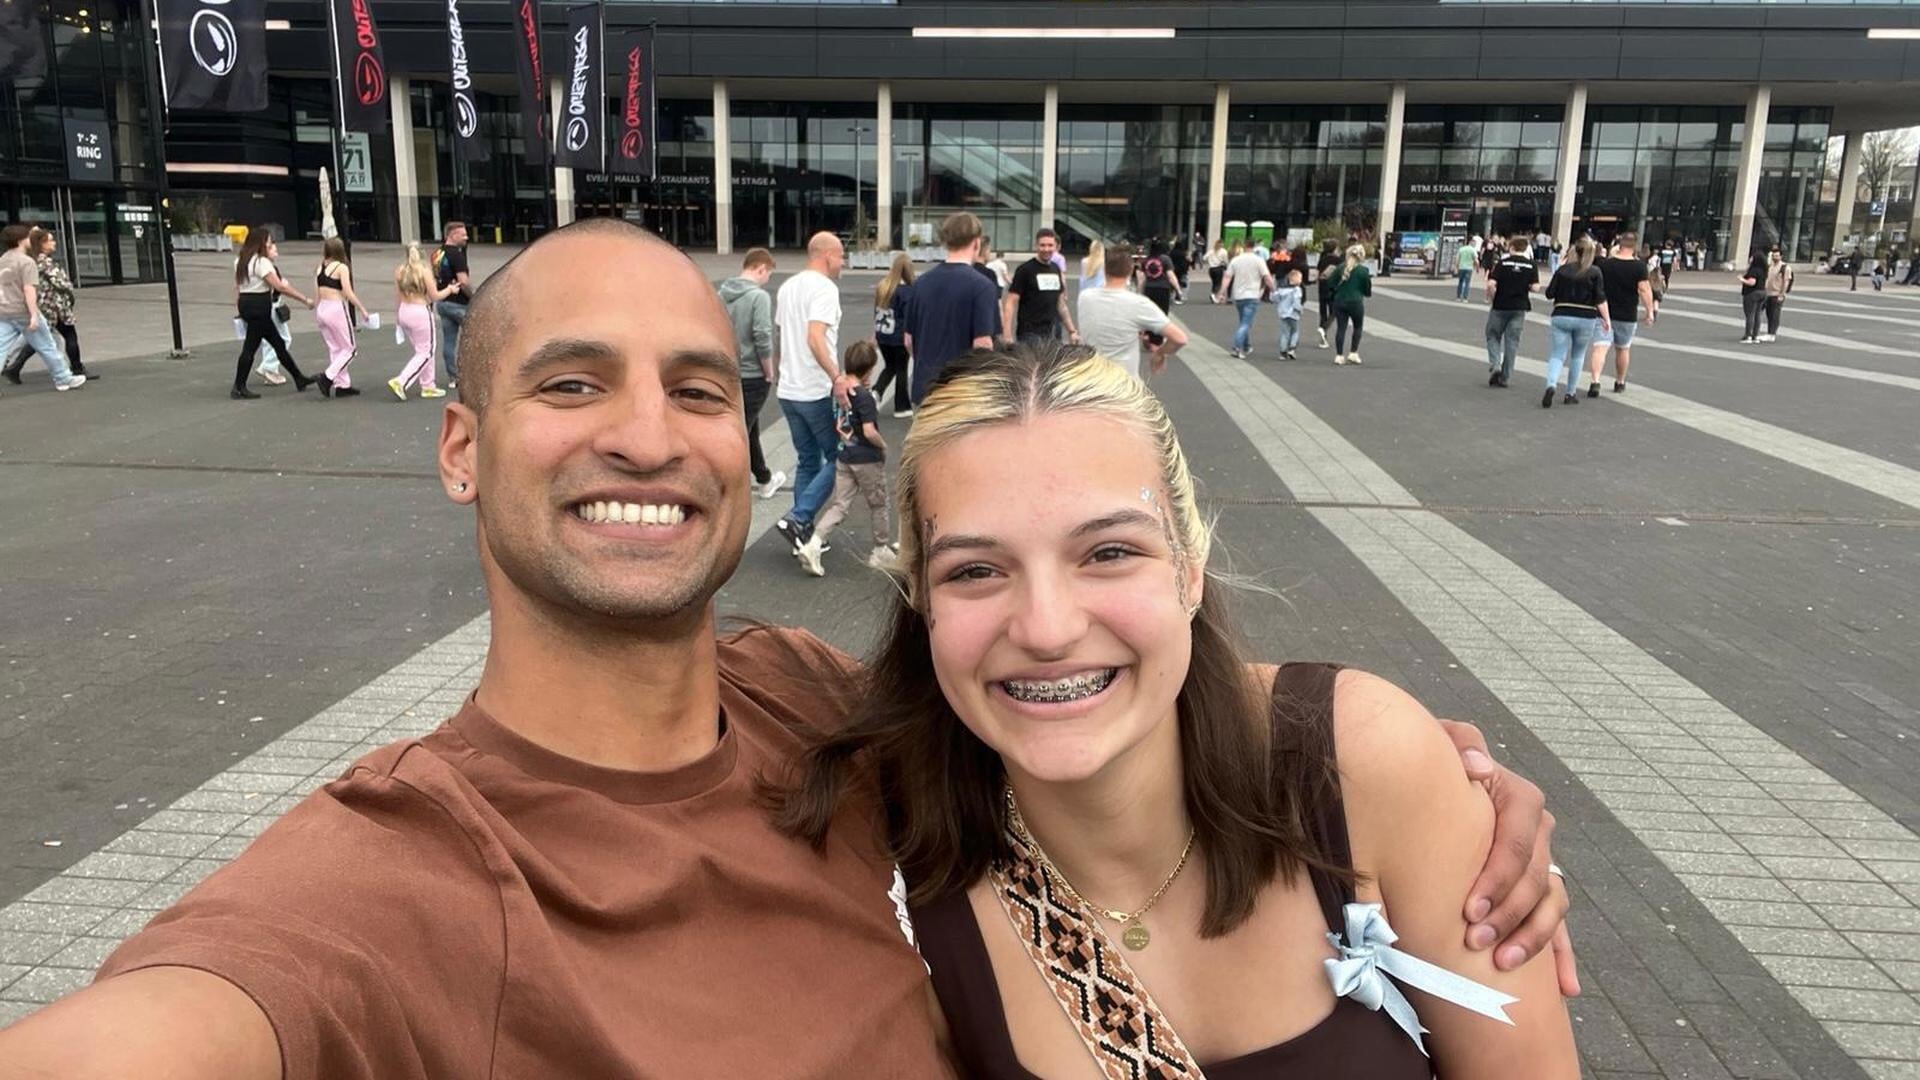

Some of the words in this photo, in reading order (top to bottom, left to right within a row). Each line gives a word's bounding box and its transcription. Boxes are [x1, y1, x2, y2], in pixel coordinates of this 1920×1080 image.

[76, 145, 102, 160] RING
[344, 149, 364, 170] 71
[614, 175, 641, 183] HALLS
[741, 177, 769, 186] STAGE
[1411, 184, 1430, 193] RTM
[1433, 185, 1461, 194] STAGE
[1464, 185, 1471, 193] B
[1481, 185, 1546, 194] CONVENTION
